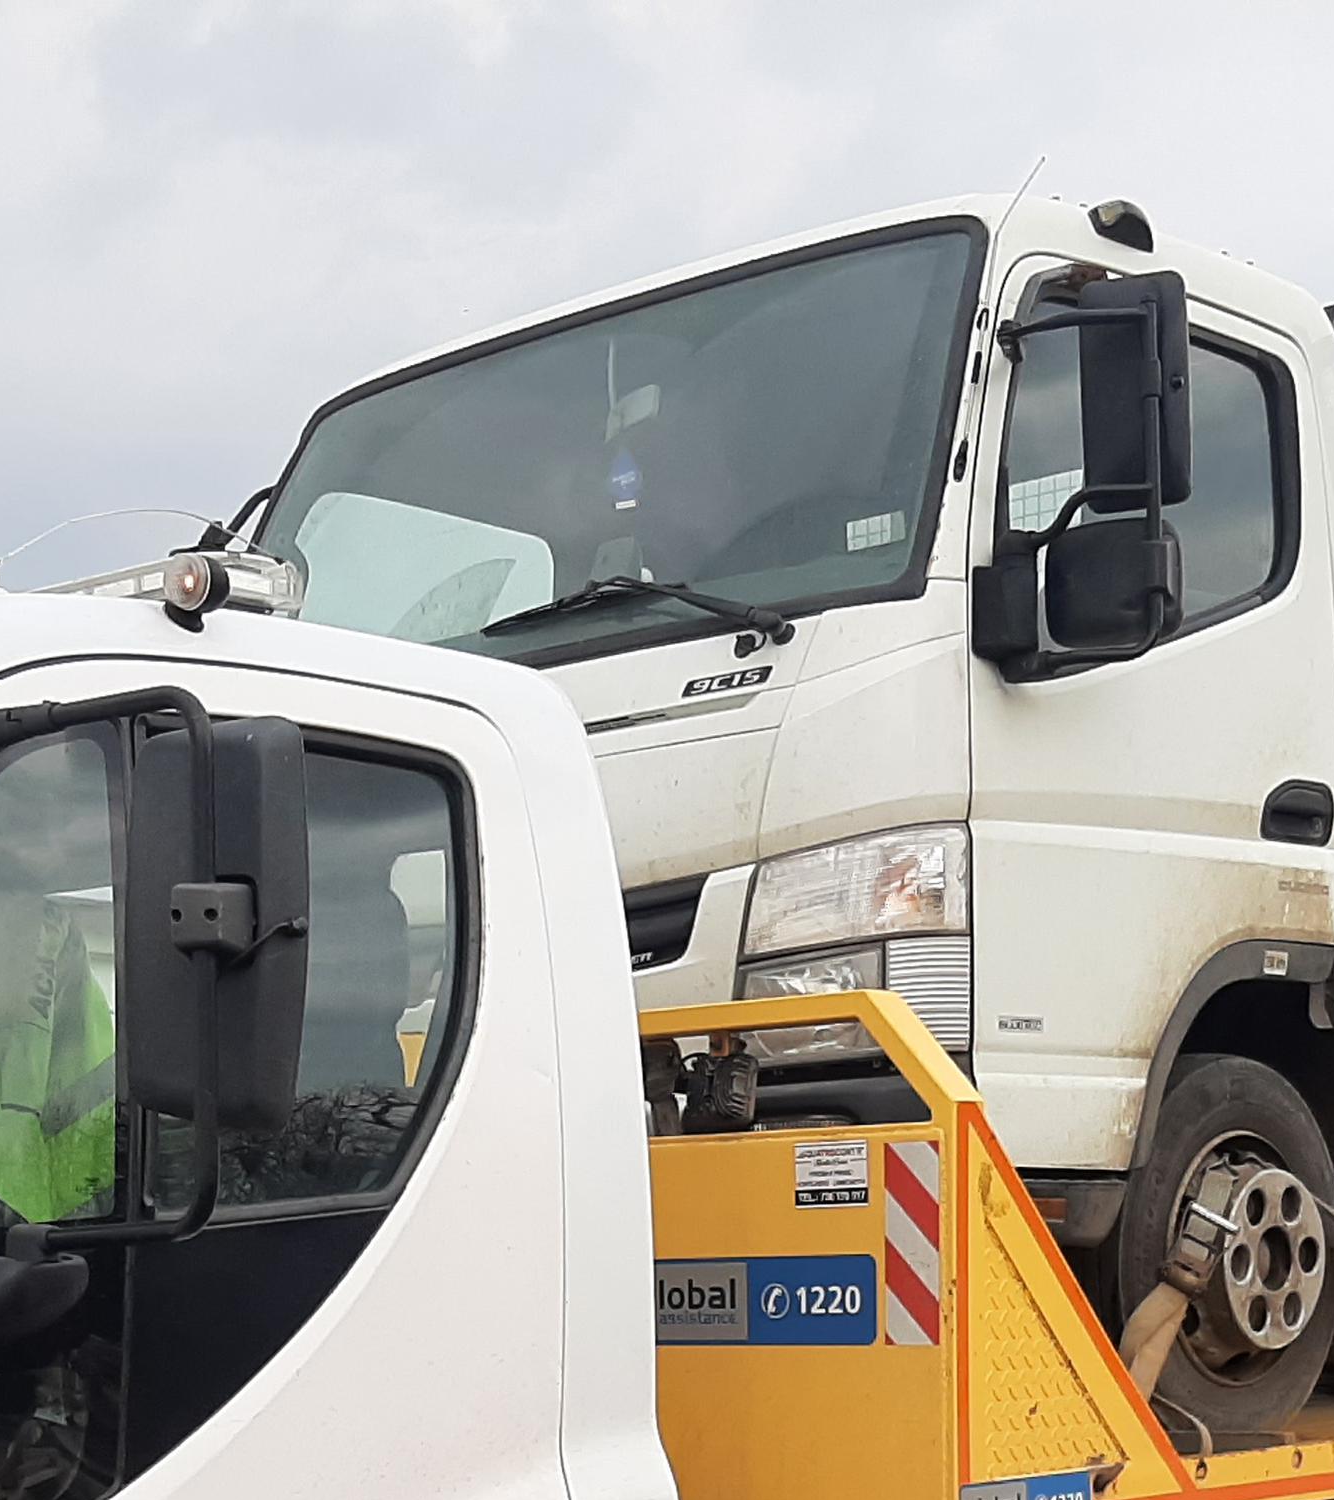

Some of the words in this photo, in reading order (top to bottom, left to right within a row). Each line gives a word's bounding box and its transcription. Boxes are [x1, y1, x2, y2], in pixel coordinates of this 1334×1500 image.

[691, 670, 760, 694] 9C15
[659, 1278, 736, 1309] lobal
[796, 1286, 861, 1314] 1220
